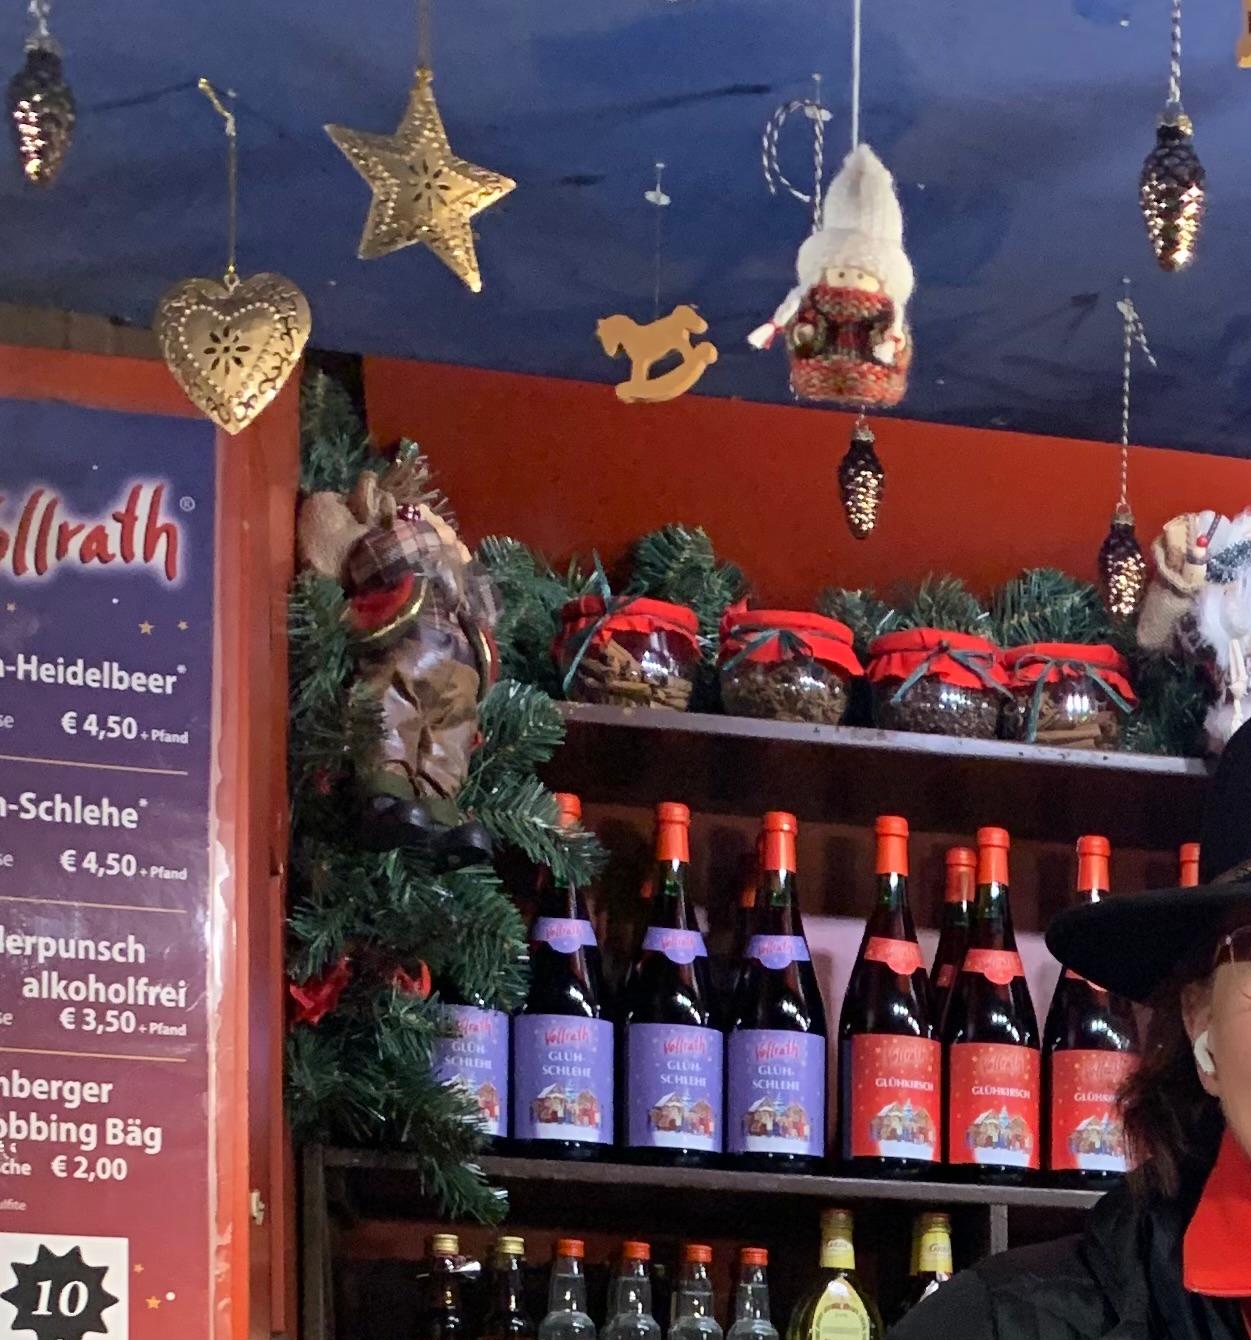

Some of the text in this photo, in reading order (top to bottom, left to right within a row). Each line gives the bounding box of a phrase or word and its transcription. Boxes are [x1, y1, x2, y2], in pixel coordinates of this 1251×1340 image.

[0, 484, 178, 581] llrath
[82, 713, 138, 740] 4,50
[151, 729, 189, 744] Pfand
[82, 851, 137, 877] 4,50
[150, 865, 188, 880] Pfand
[0, 925, 146, 964] erpunsch
[22, 970, 188, 1008] alkoholfrei
[81, 1008, 136, 1035] 3,50
[149, 1022, 187, 1037] Pfand
[105, 1117, 163, 1155] Bäg
[73, 1155, 128, 1183] 2,00
[31, 1280, 89, 1317] 10
